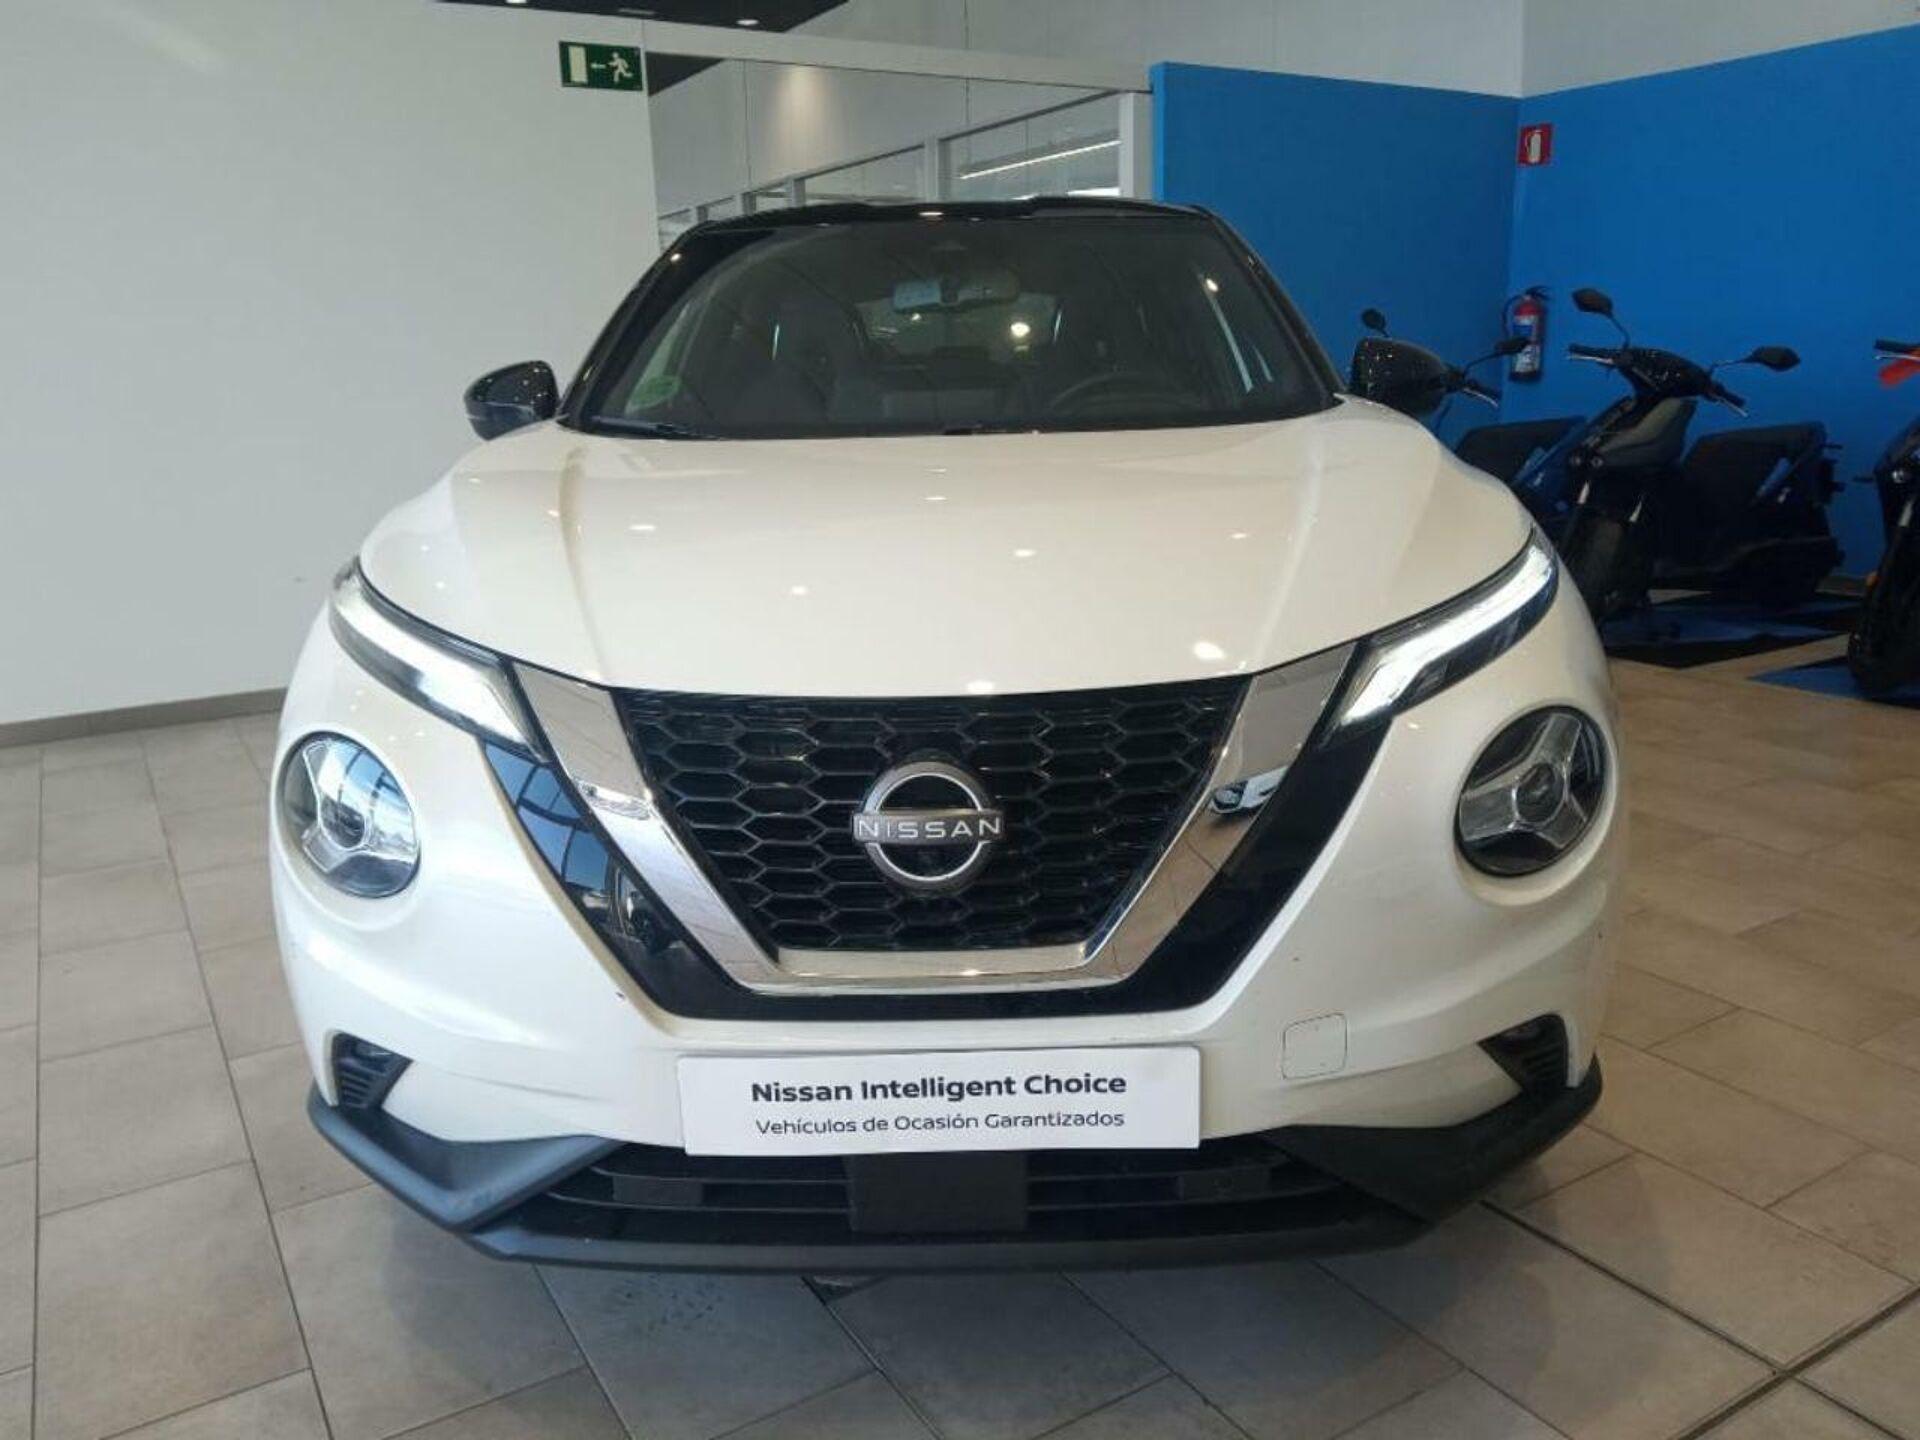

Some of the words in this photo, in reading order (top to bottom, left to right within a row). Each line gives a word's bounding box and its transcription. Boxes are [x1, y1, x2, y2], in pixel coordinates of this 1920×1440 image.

[858, 816, 1001, 838] NISSAN
[751, 1081, 853, 1102] Nissan
[861, 1076, 1017, 1103] Intelligent
[1023, 1072, 1127, 1095] Choice
[755, 1116, 857, 1135] Vehículos
[862, 1116, 889, 1132] de
[894, 1112, 979, 1131] Ocasión
[984, 1110, 1126, 1130] Garantizados
